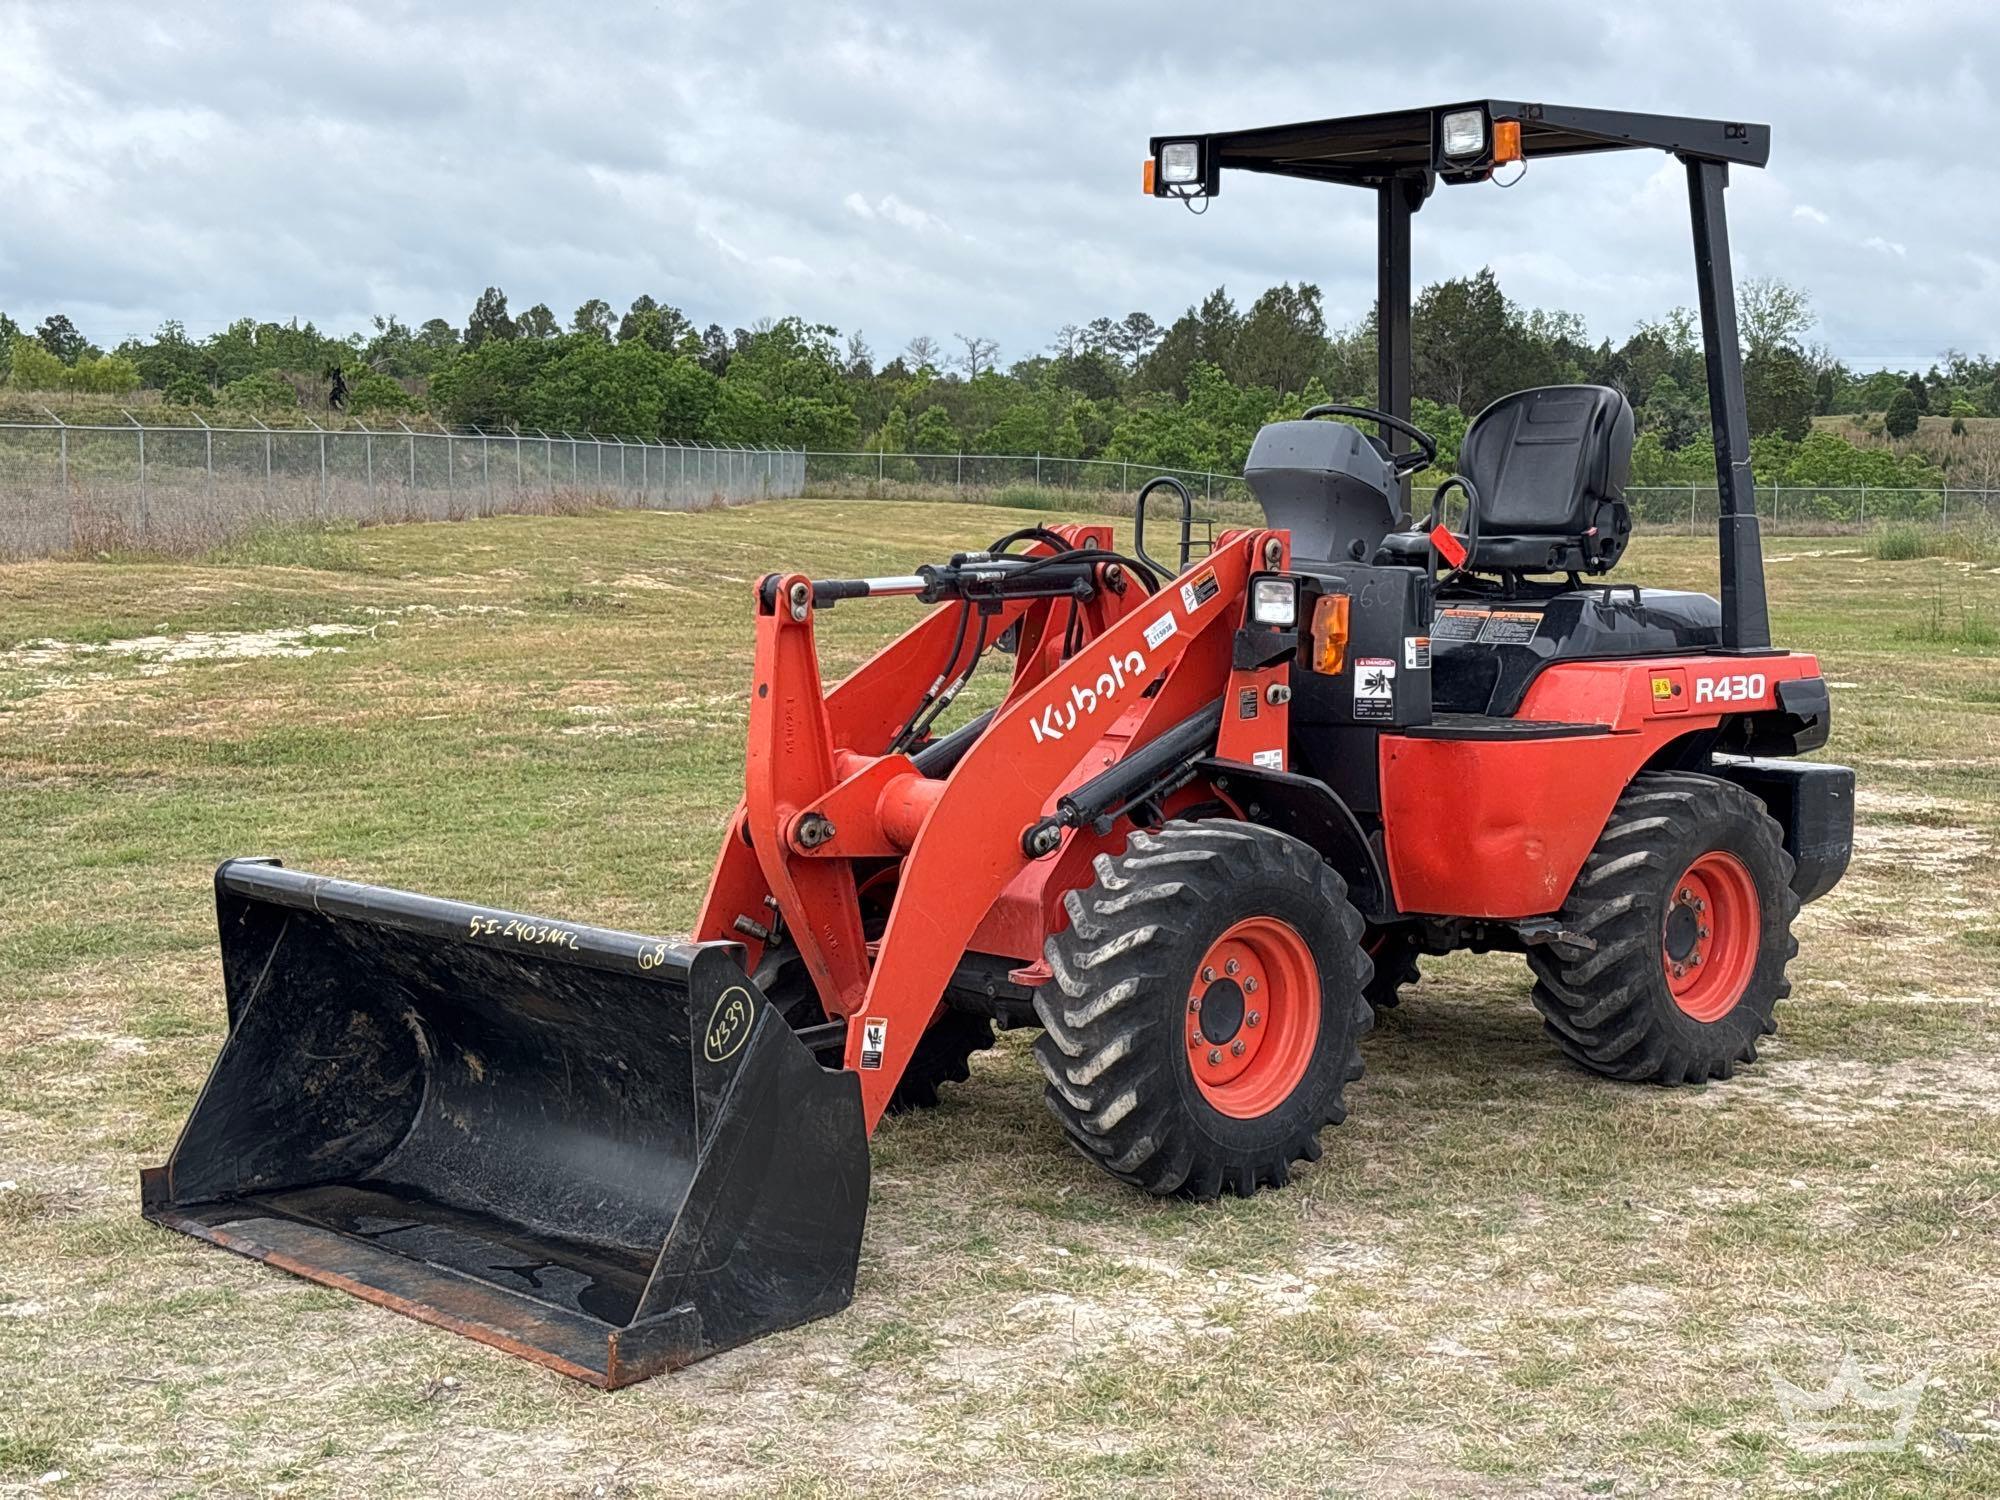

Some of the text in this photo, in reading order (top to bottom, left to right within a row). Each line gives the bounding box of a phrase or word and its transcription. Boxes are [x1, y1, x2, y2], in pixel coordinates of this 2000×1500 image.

[1029, 650, 1147, 744] Kubota
[1695, 673, 1766, 703] R430
[709, 1000, 745, 1055] 4339
